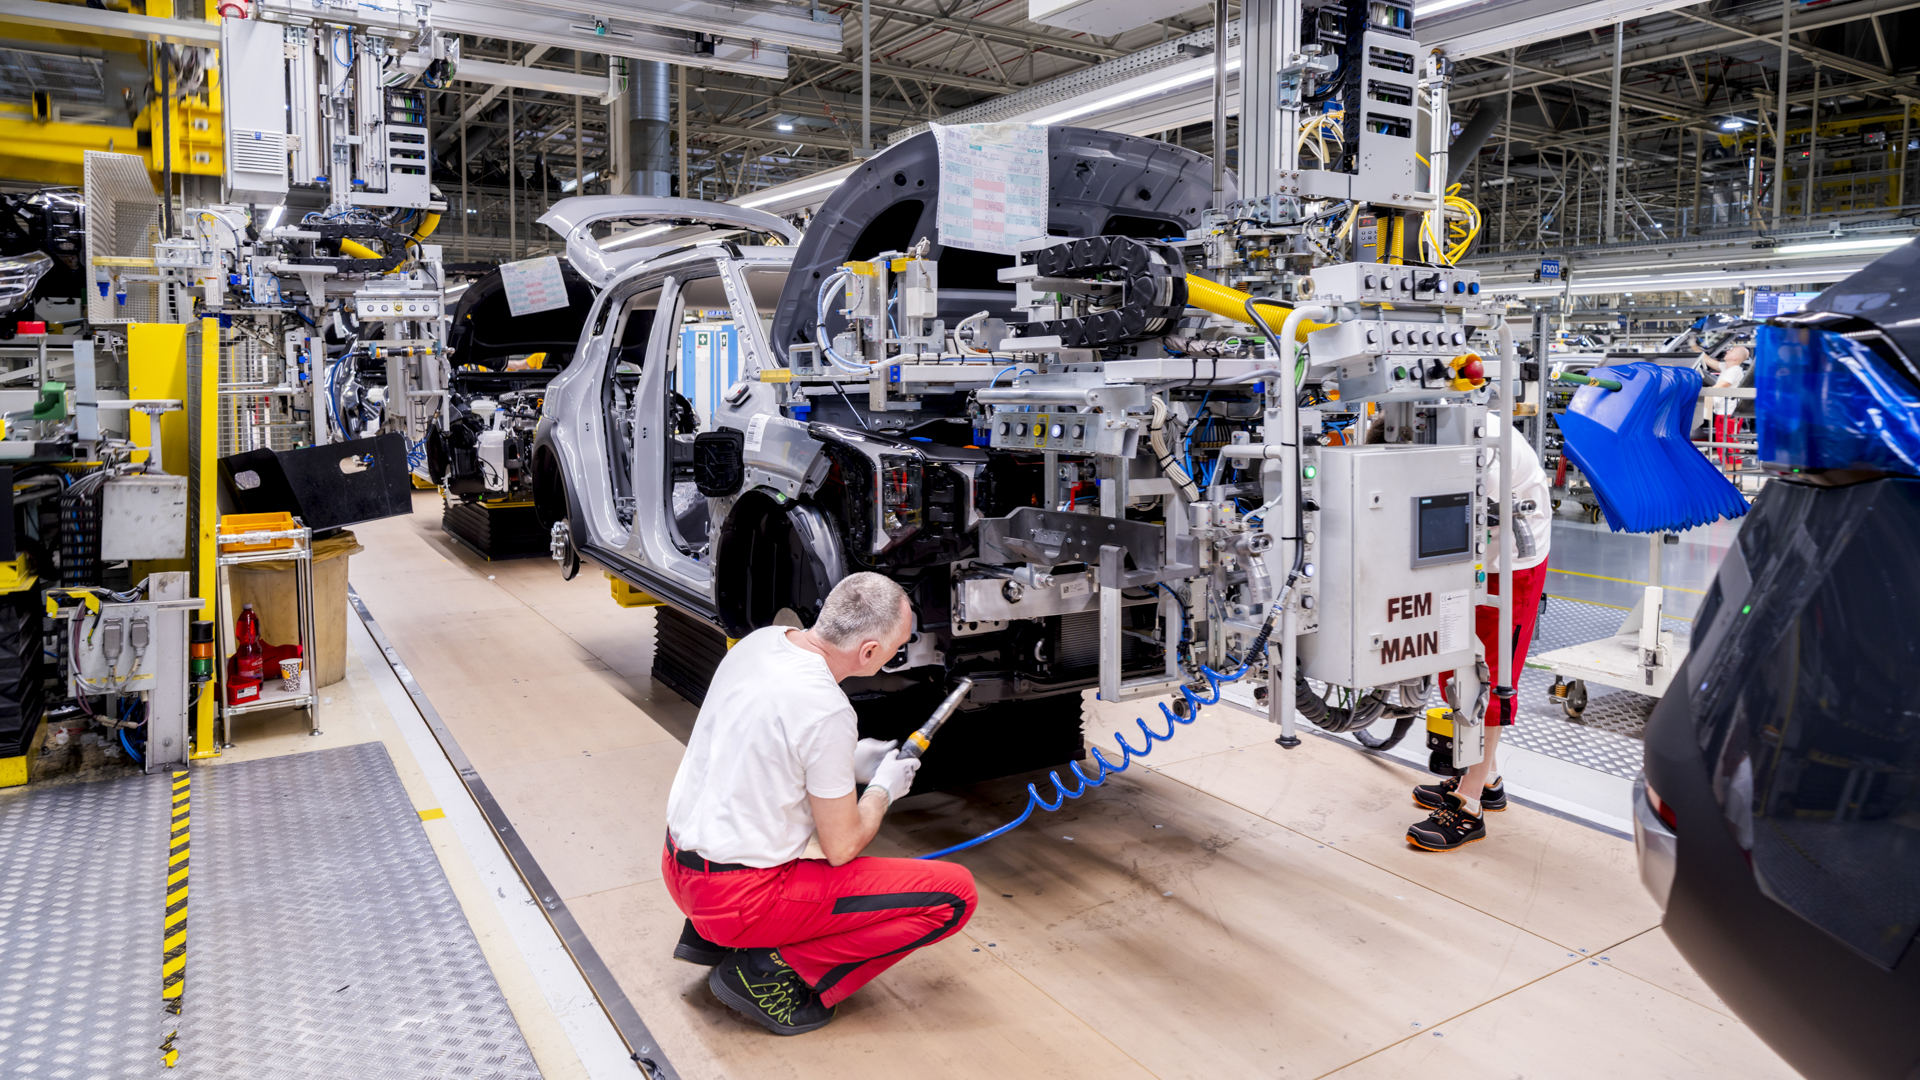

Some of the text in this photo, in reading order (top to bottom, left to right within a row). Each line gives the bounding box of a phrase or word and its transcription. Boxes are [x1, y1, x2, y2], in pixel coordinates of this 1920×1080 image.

[1542, 264, 1558, 274] F303
[1387, 592, 1432, 623] FEM
[1381, 630, 1438, 665] MAIN
